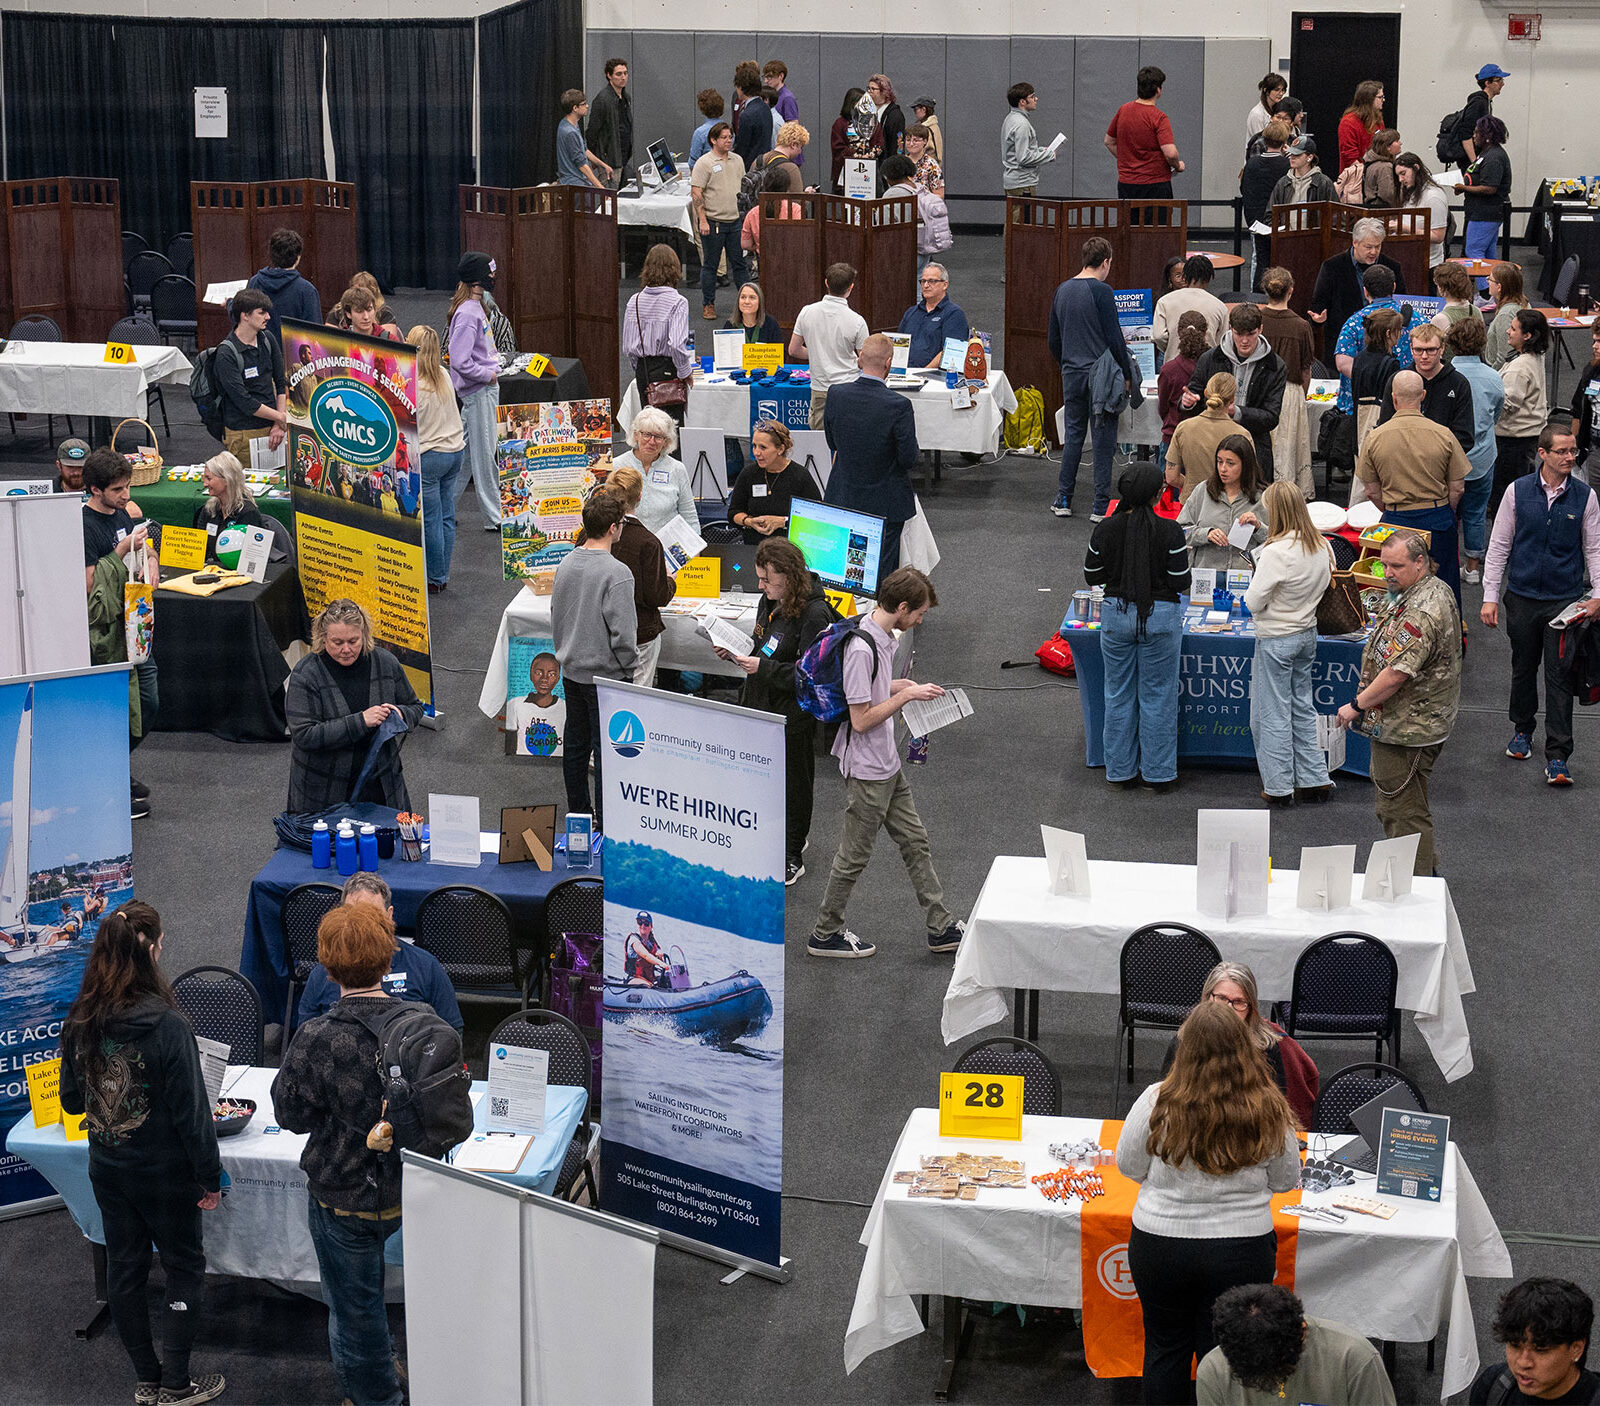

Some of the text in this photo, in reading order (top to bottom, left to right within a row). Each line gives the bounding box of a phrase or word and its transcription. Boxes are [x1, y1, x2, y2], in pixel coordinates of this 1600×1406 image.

[111, 347, 123, 359] 10
[534, 360, 543, 372] 11
[290, 356, 416, 415] CROWD MANAGEMENT & SECURITY
[332, 419, 376, 447] GMCS
[534, 429, 575, 441] PATCHWORK
[542, 436, 568, 444] PLANET
[530, 448, 540, 456] ART
[561, 445, 583, 453] BORDERS
[301, 521, 333, 536] Athletic Events
[302, 533, 363, 556] Commencement Ceremonies
[377, 544, 406, 557] Quad Bonfire
[510, 541, 530, 549] VERMONT
[338, 552, 353, 563] Events
[377, 555, 392, 565] Naked
[377, 565, 400, 577] Street Fair
[378, 576, 420, 594] Library Overnights
[379, 586, 391, 596] Move
[531, 717, 547, 725] ART
[525, 726, 556, 735] ACROSS
[528, 737, 562, 747] BORDERS
[649, 731, 772, 766] community sailing center
[620, 781, 758, 831] WE'RE HIRING!
[640, 815, 732, 849] SUMMER JOBS
[0, 1021, 64, 1046] KE ACC
[0, 1058, 8, 1073] E
[32, 1070, 52, 1081] Lake
[965, 1082, 1004, 1108] 28
[648, 1092, 727, 1122] SAILING INSTRUCTORS
[634, 1100, 743, 1139] WATERFRONT COORDINATORS
[678, 1126, 703, 1139] MORE!
[235, 1177, 286, 1189] community
[624, 1162, 752, 1210] www.communitysailingcenter.org
[617, 1172, 760, 1227] 505 Lake Street Burlington, VT 05401
[656, 1201, 718, 1228] (802) 864-2499
